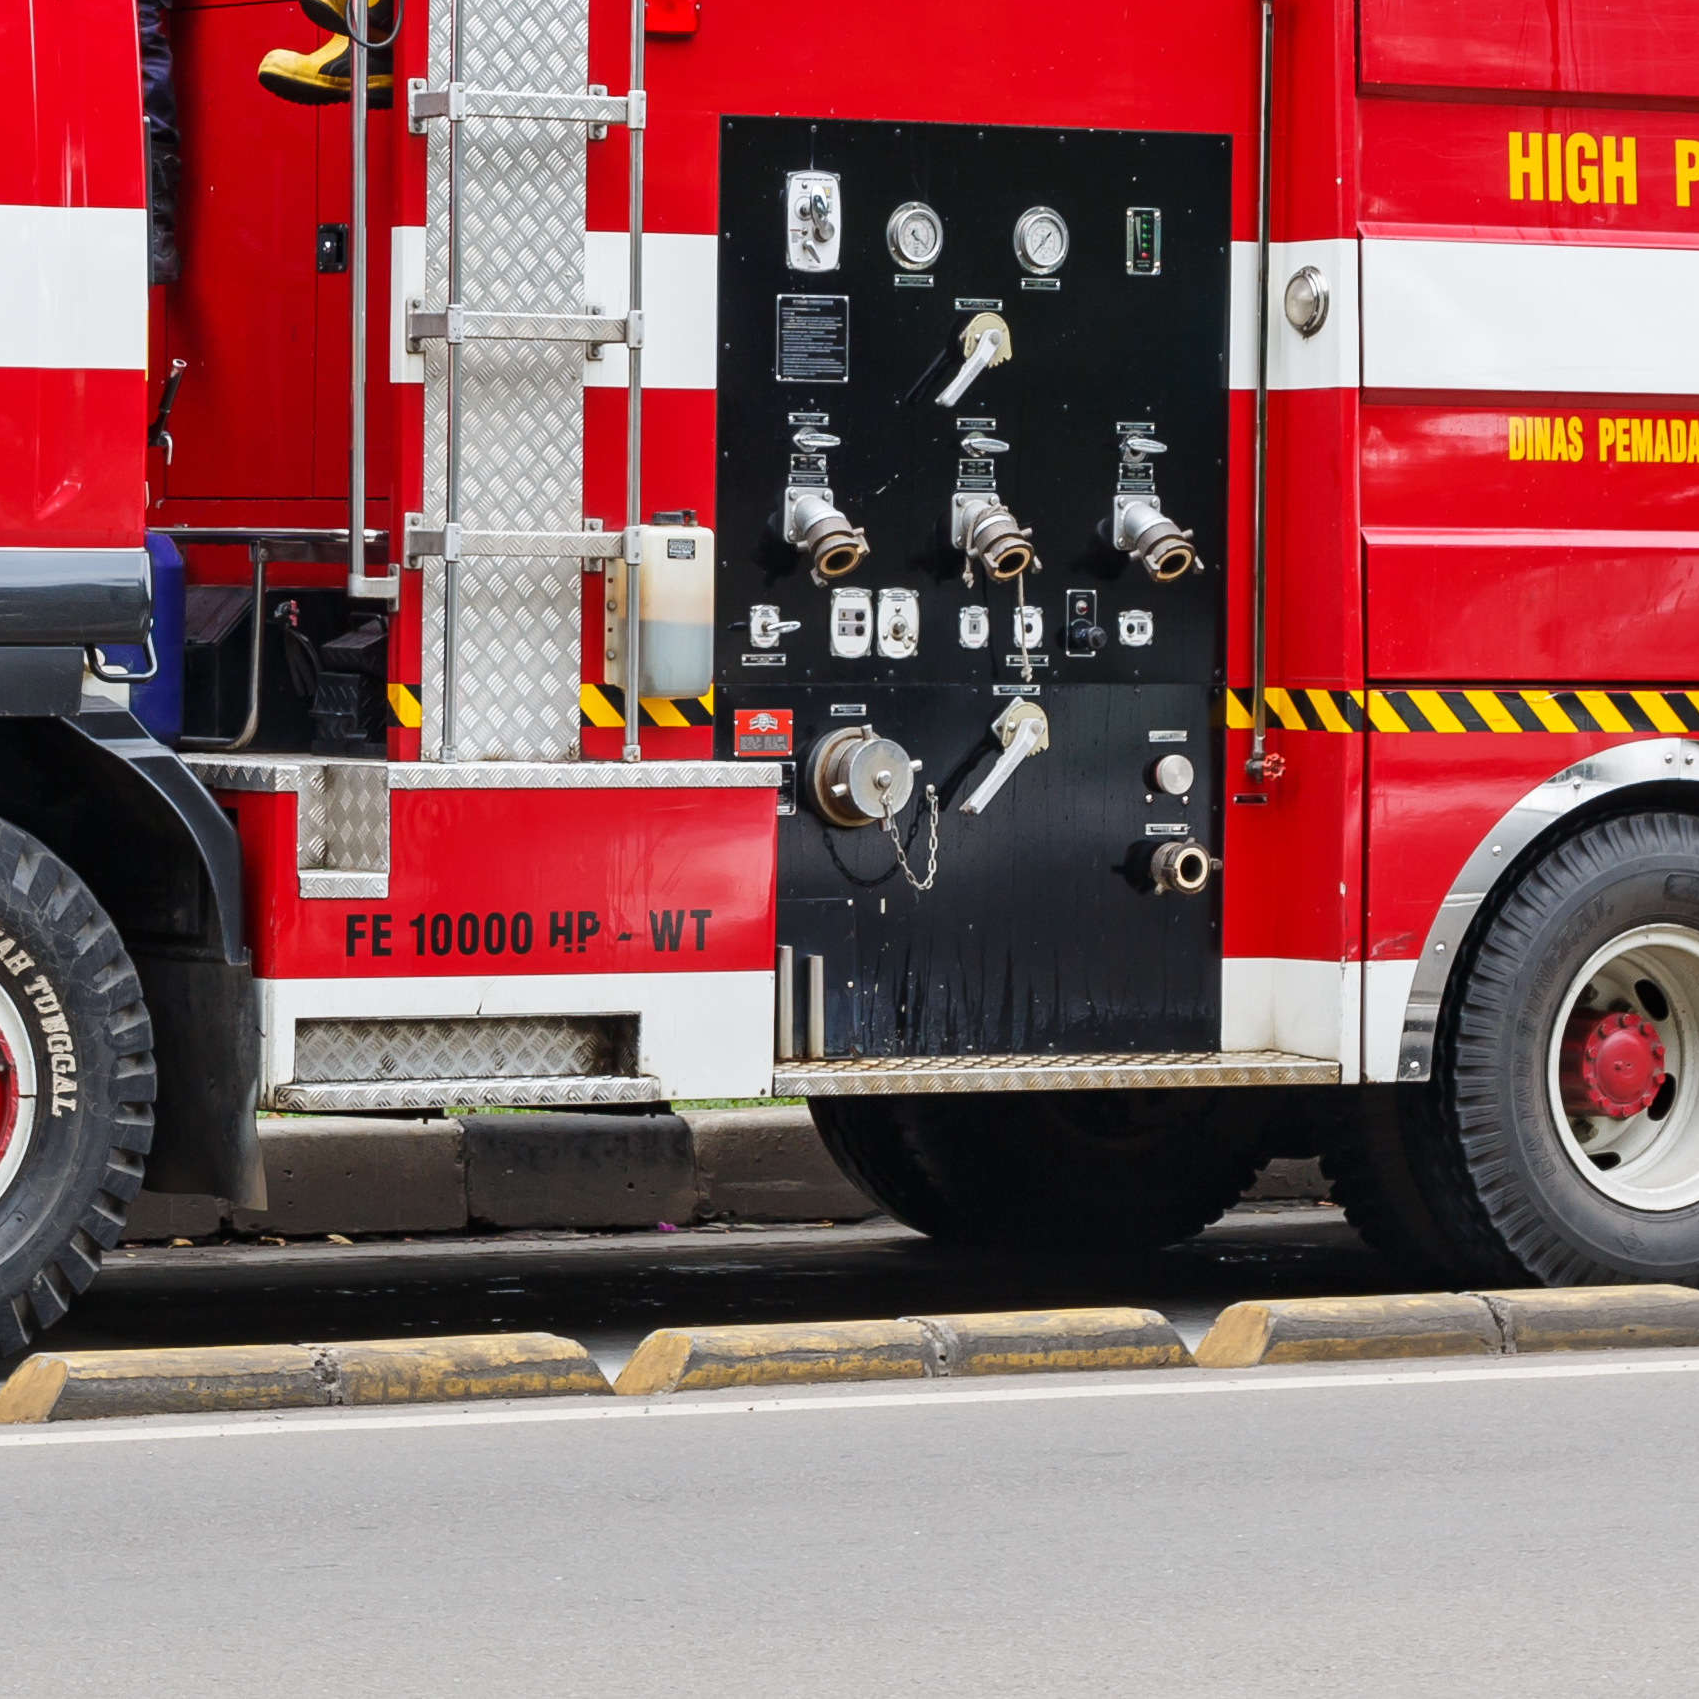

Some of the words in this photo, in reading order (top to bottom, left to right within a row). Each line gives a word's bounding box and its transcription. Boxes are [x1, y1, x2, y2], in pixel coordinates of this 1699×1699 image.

[1508, 131, 1638, 206] HIGH
[1508, 416, 1584, 462] DINAS
[345, 914, 393, 957] FE
[409, 911, 534, 956] 10000
[548, 910, 602, 953] HP
[648, 909, 713, 952] WT
[24, 974, 78, 1118] TUNGGAL
